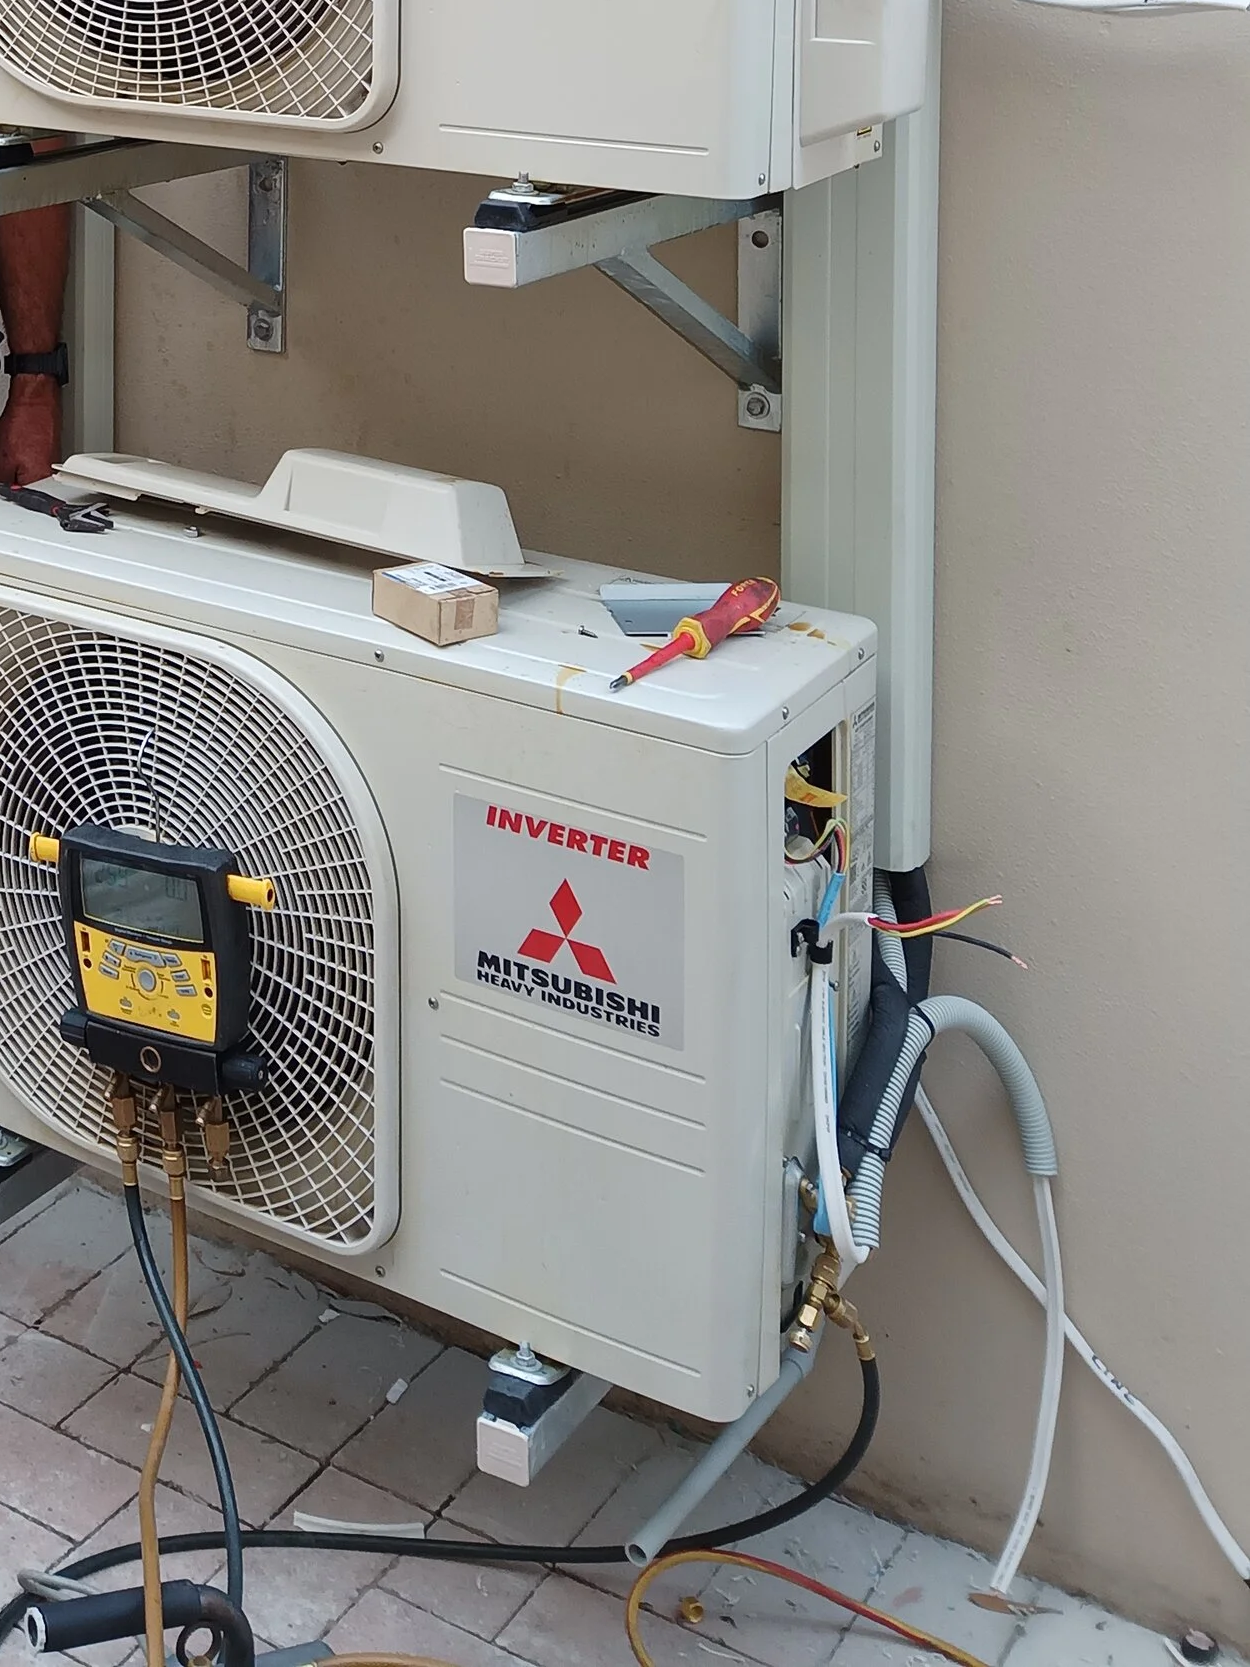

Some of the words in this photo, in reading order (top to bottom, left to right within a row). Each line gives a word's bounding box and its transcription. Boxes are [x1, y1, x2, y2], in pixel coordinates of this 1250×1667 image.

[486, 805, 650, 871] INVERTER
[477, 950, 661, 1025] MITSUBISHI
[477, 969, 535, 998] HEAVY
[541, 989, 661, 1037] INDUSTRIES
